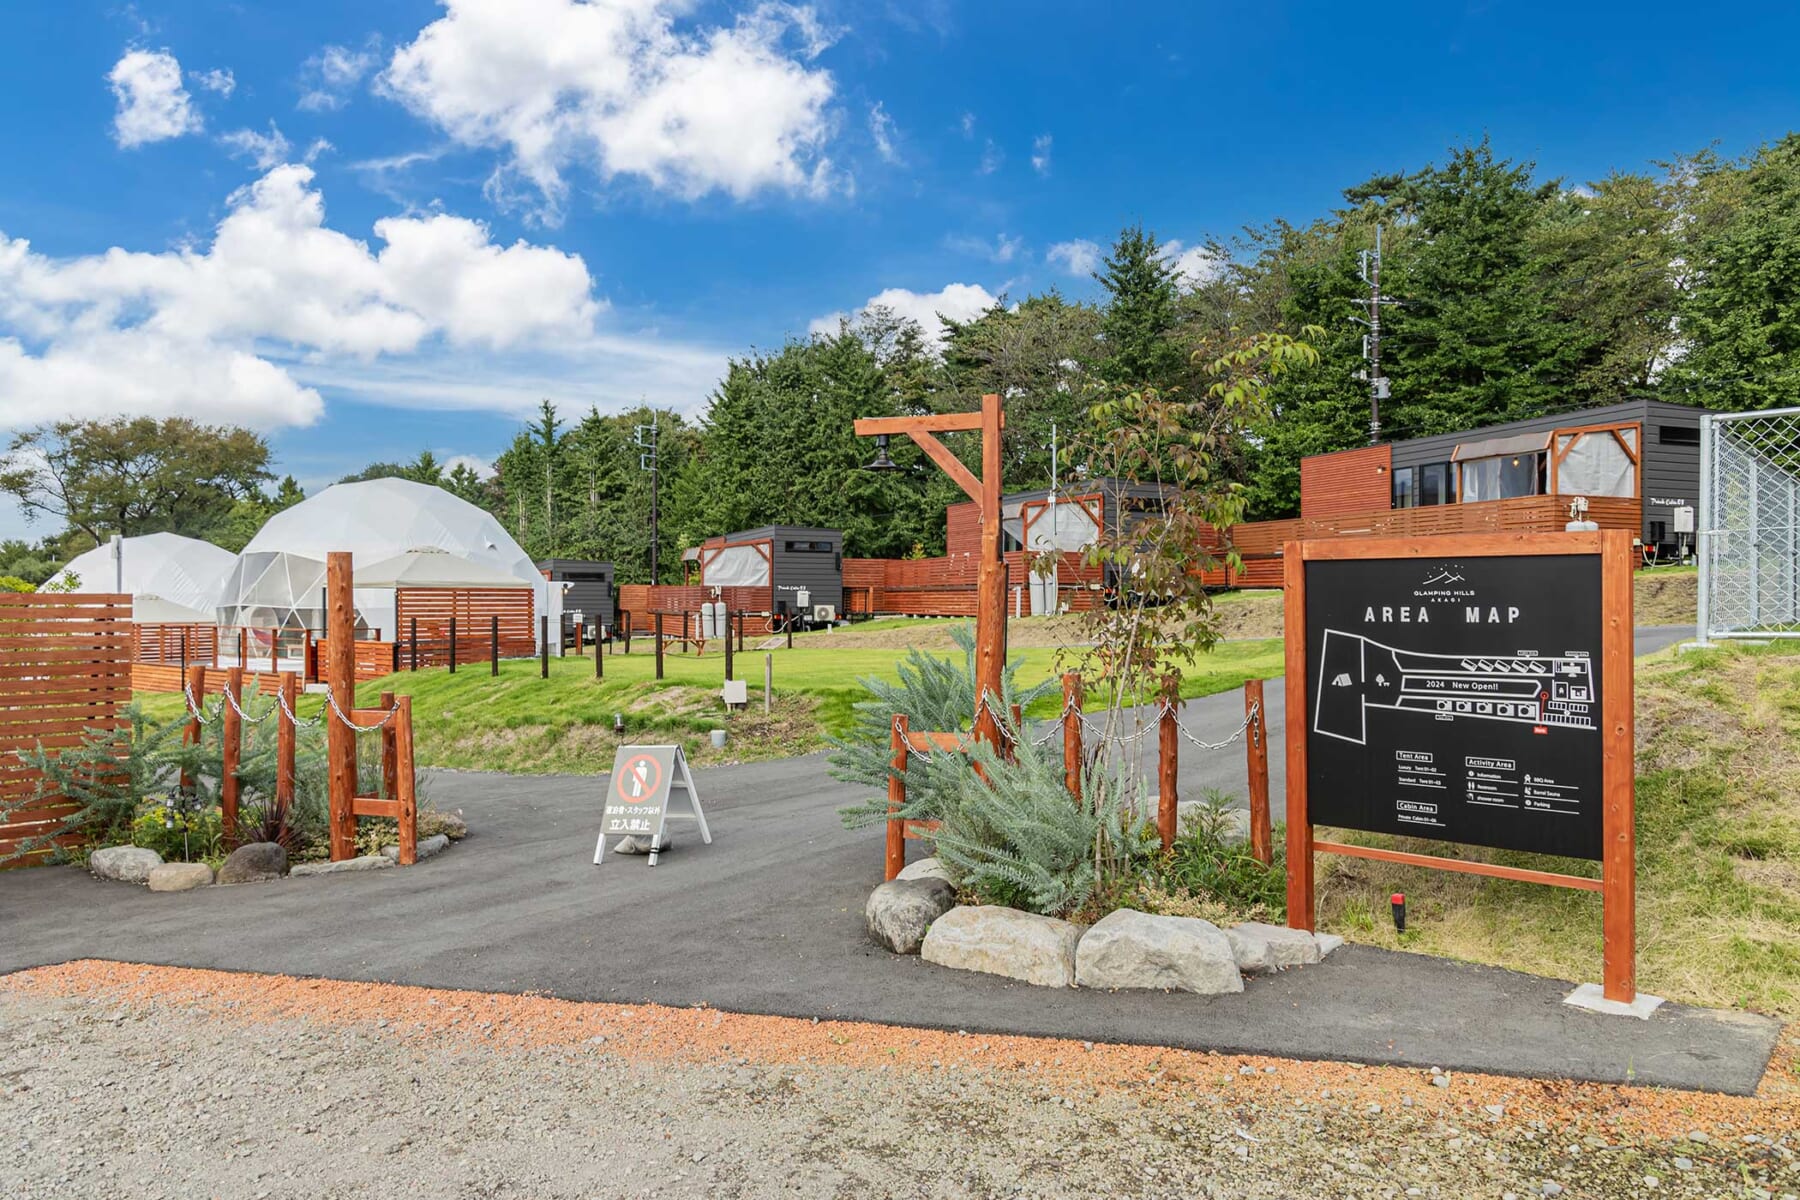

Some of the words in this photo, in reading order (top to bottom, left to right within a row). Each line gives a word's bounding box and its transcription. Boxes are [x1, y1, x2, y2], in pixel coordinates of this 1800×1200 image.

[1364, 606, 1430, 623] AREA
[1466, 606, 1521, 624] MAP
[1426, 680, 1445, 688] 2024
[1471, 682, 1498, 692] Open!!
[1469, 759, 1495, 768] Activity
[1496, 761, 1512, 769] Area
[1399, 802, 1418, 810] Cabin
[1419, 804, 1434, 812] Area
[1533, 801, 1551, 809] Parking
[609, 818, 651, 831] 立入禁止
